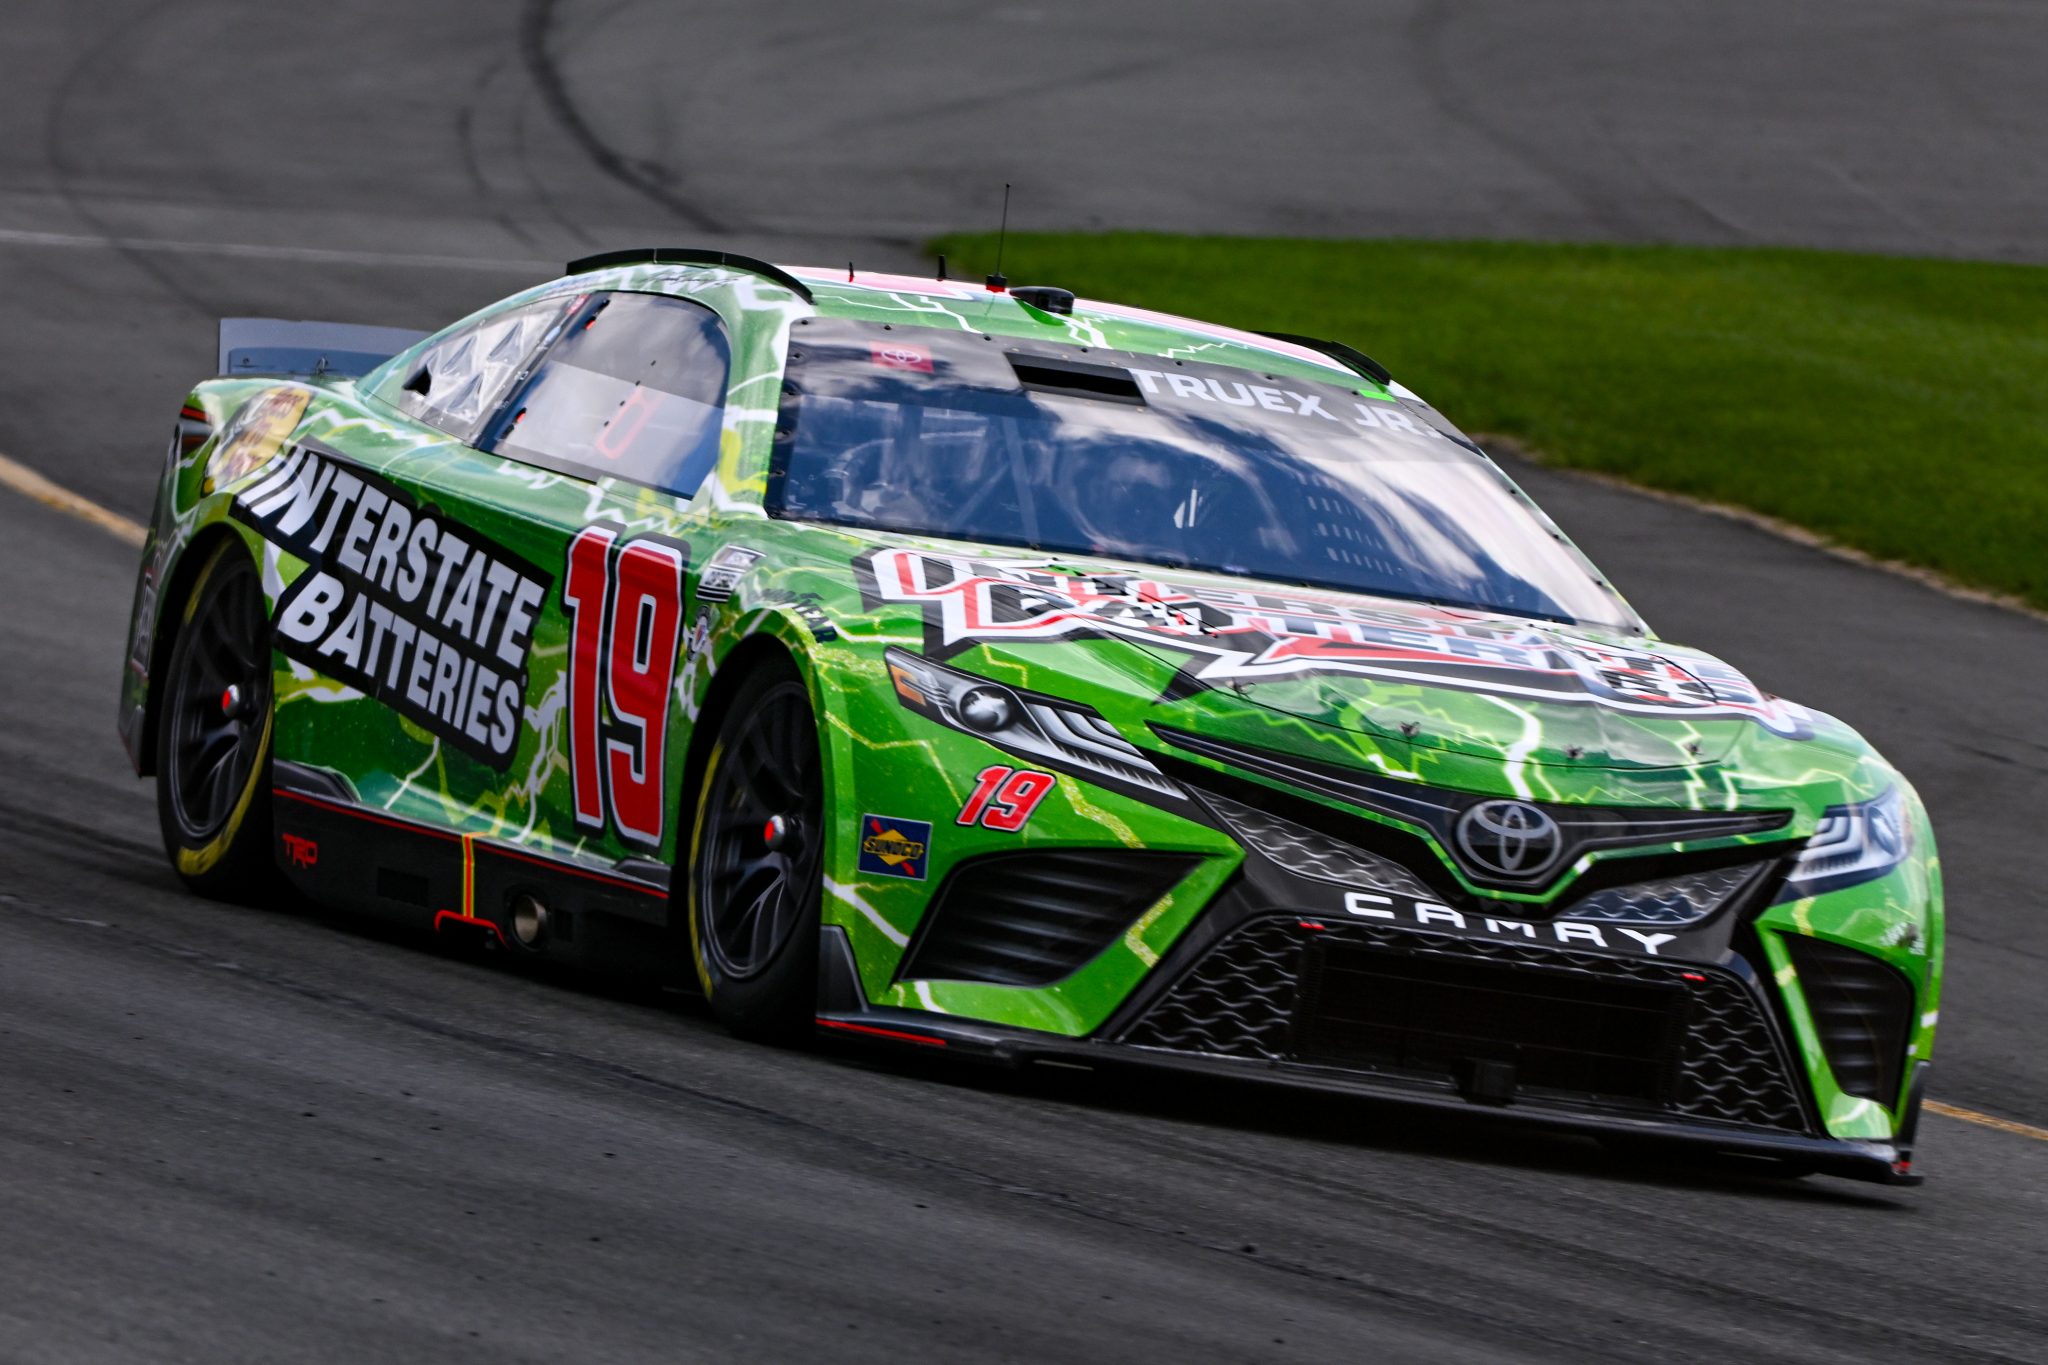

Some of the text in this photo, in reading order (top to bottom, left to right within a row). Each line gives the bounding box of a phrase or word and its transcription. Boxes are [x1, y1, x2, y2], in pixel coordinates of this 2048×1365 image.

[1127, 367, 1339, 422] TRUEX
[236, 446, 545, 669] INTERSTATE
[277, 571, 520, 755] BATTERIES
[565, 524, 683, 848] 19
[955, 765, 1056, 832] 19
[282, 832, 319, 869] TRD
[1344, 891, 1678, 955] CAMRY
